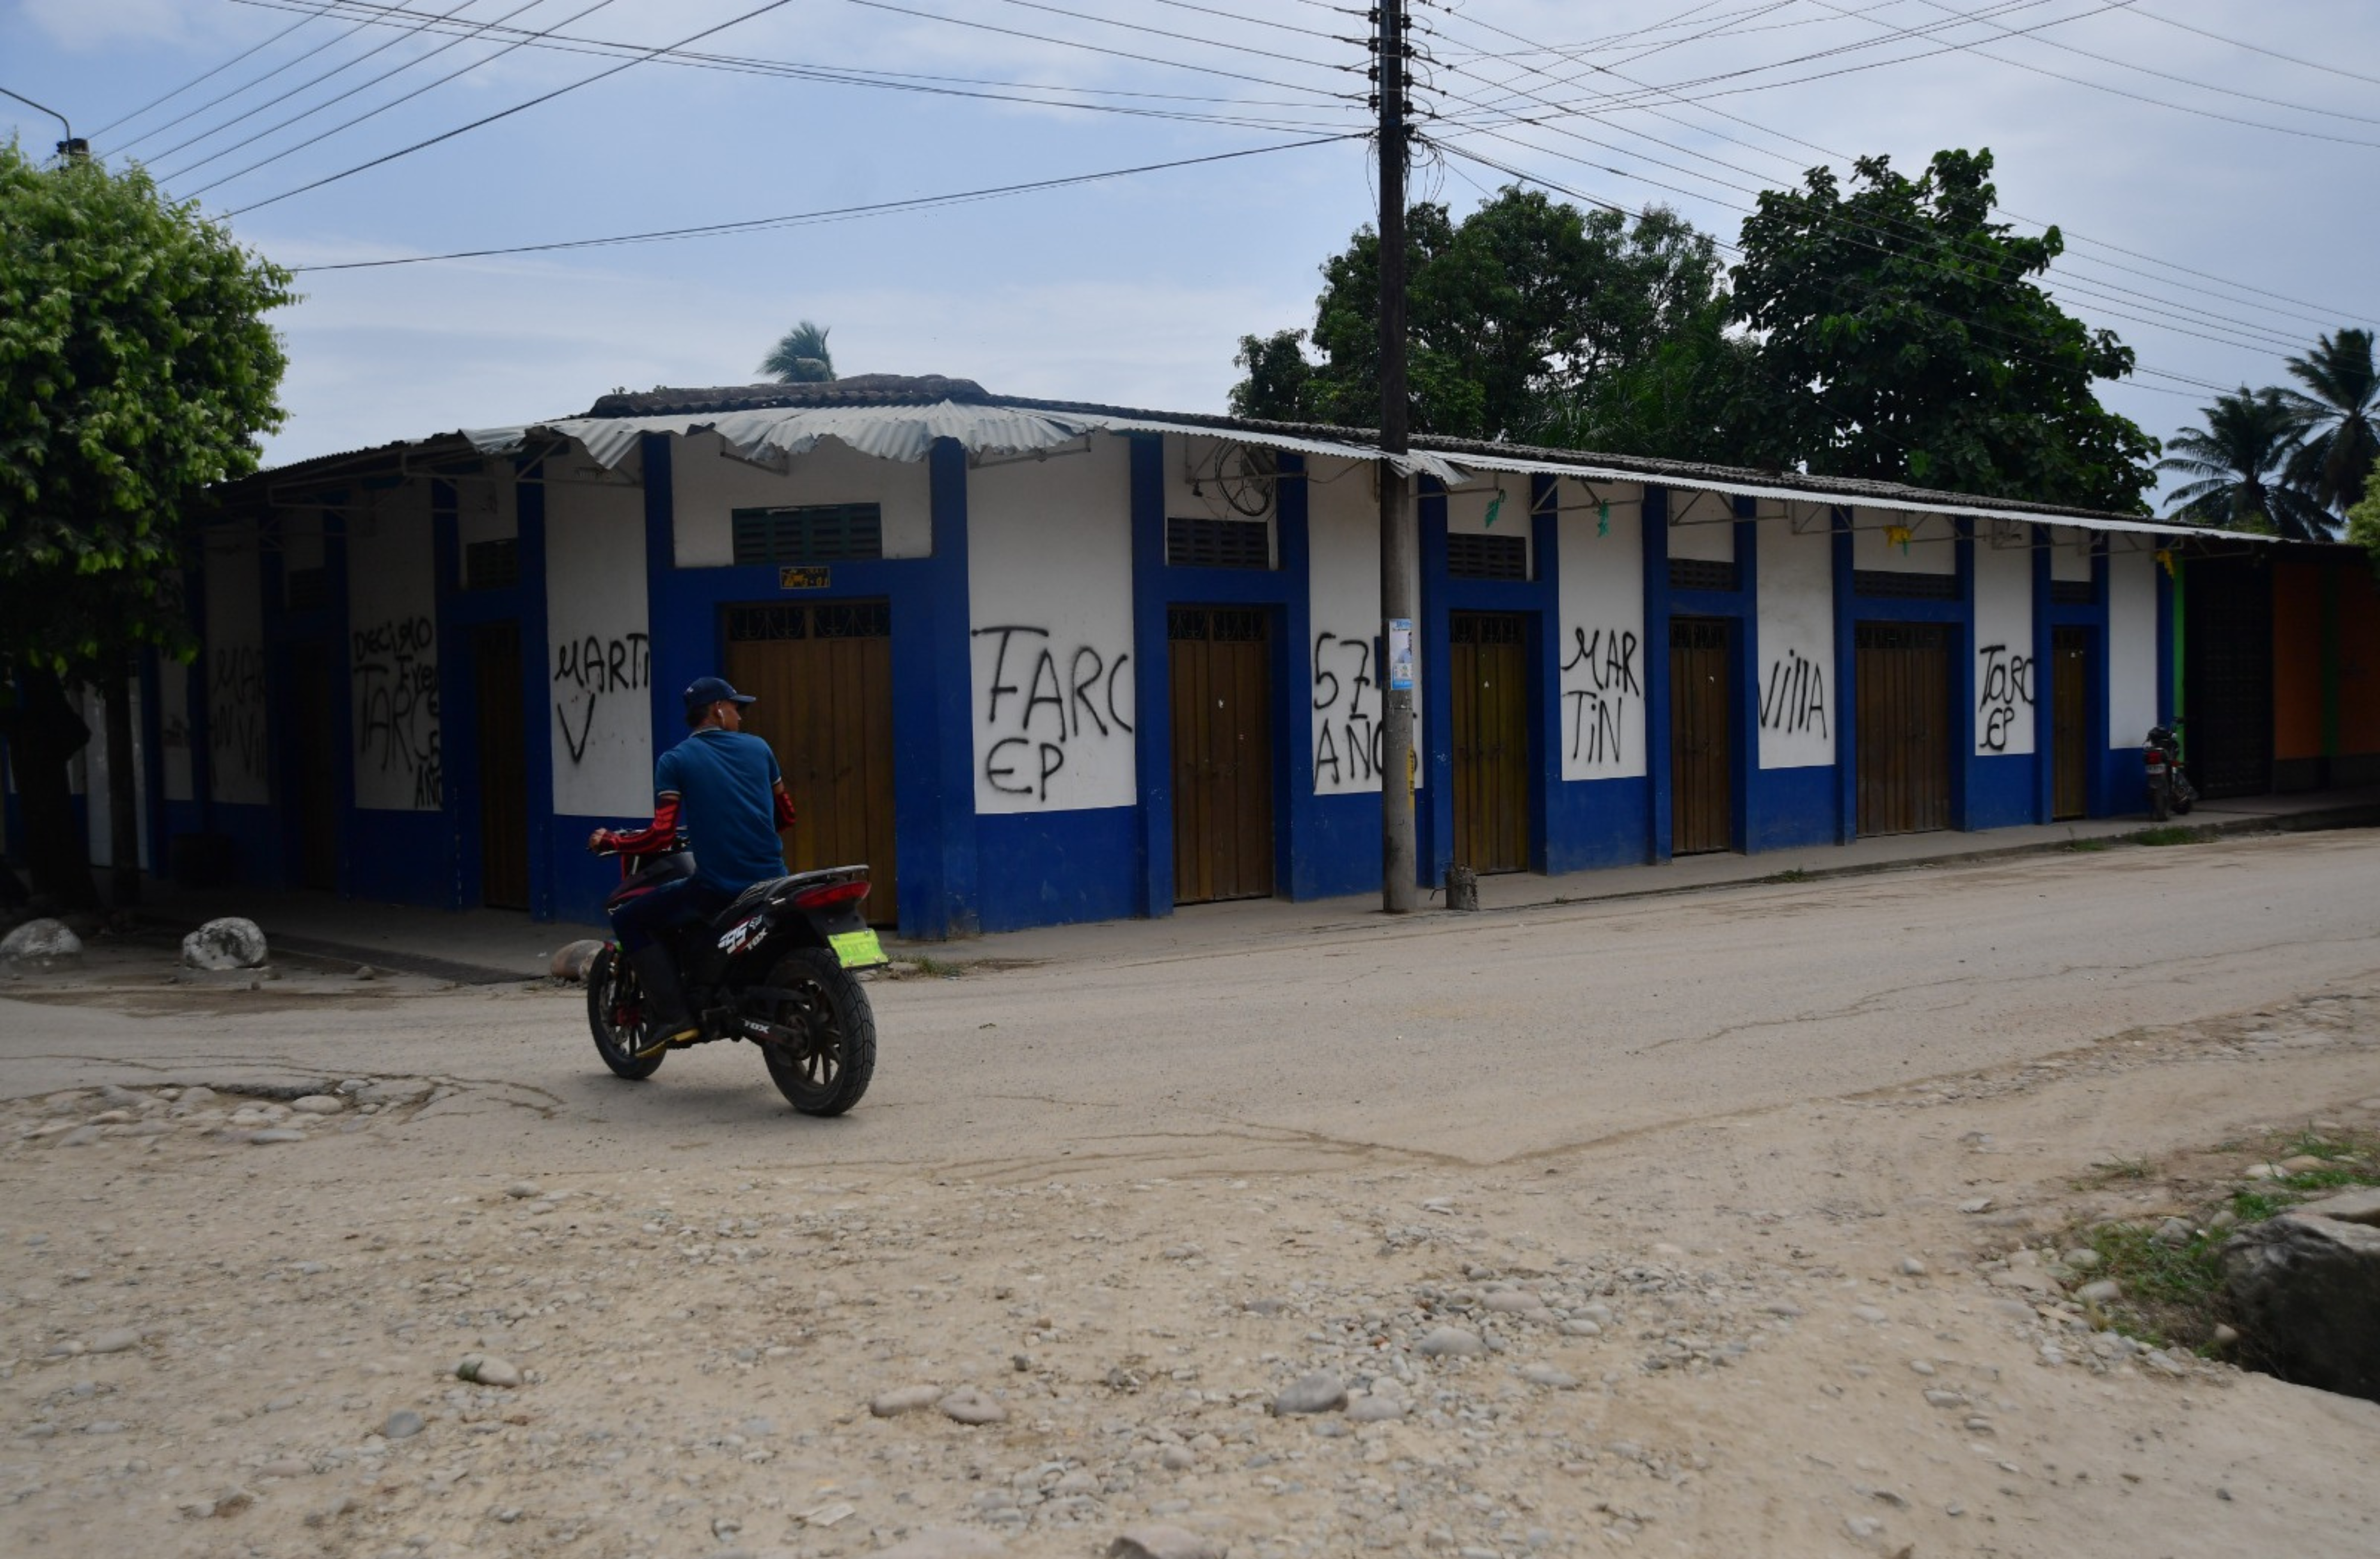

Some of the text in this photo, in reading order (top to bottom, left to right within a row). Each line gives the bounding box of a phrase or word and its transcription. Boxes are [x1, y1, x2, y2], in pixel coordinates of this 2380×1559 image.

[970, 626, 1133, 742] FARC
[1561, 626, 1640, 697] MAR
[986, 738, 1065, 802] EP
